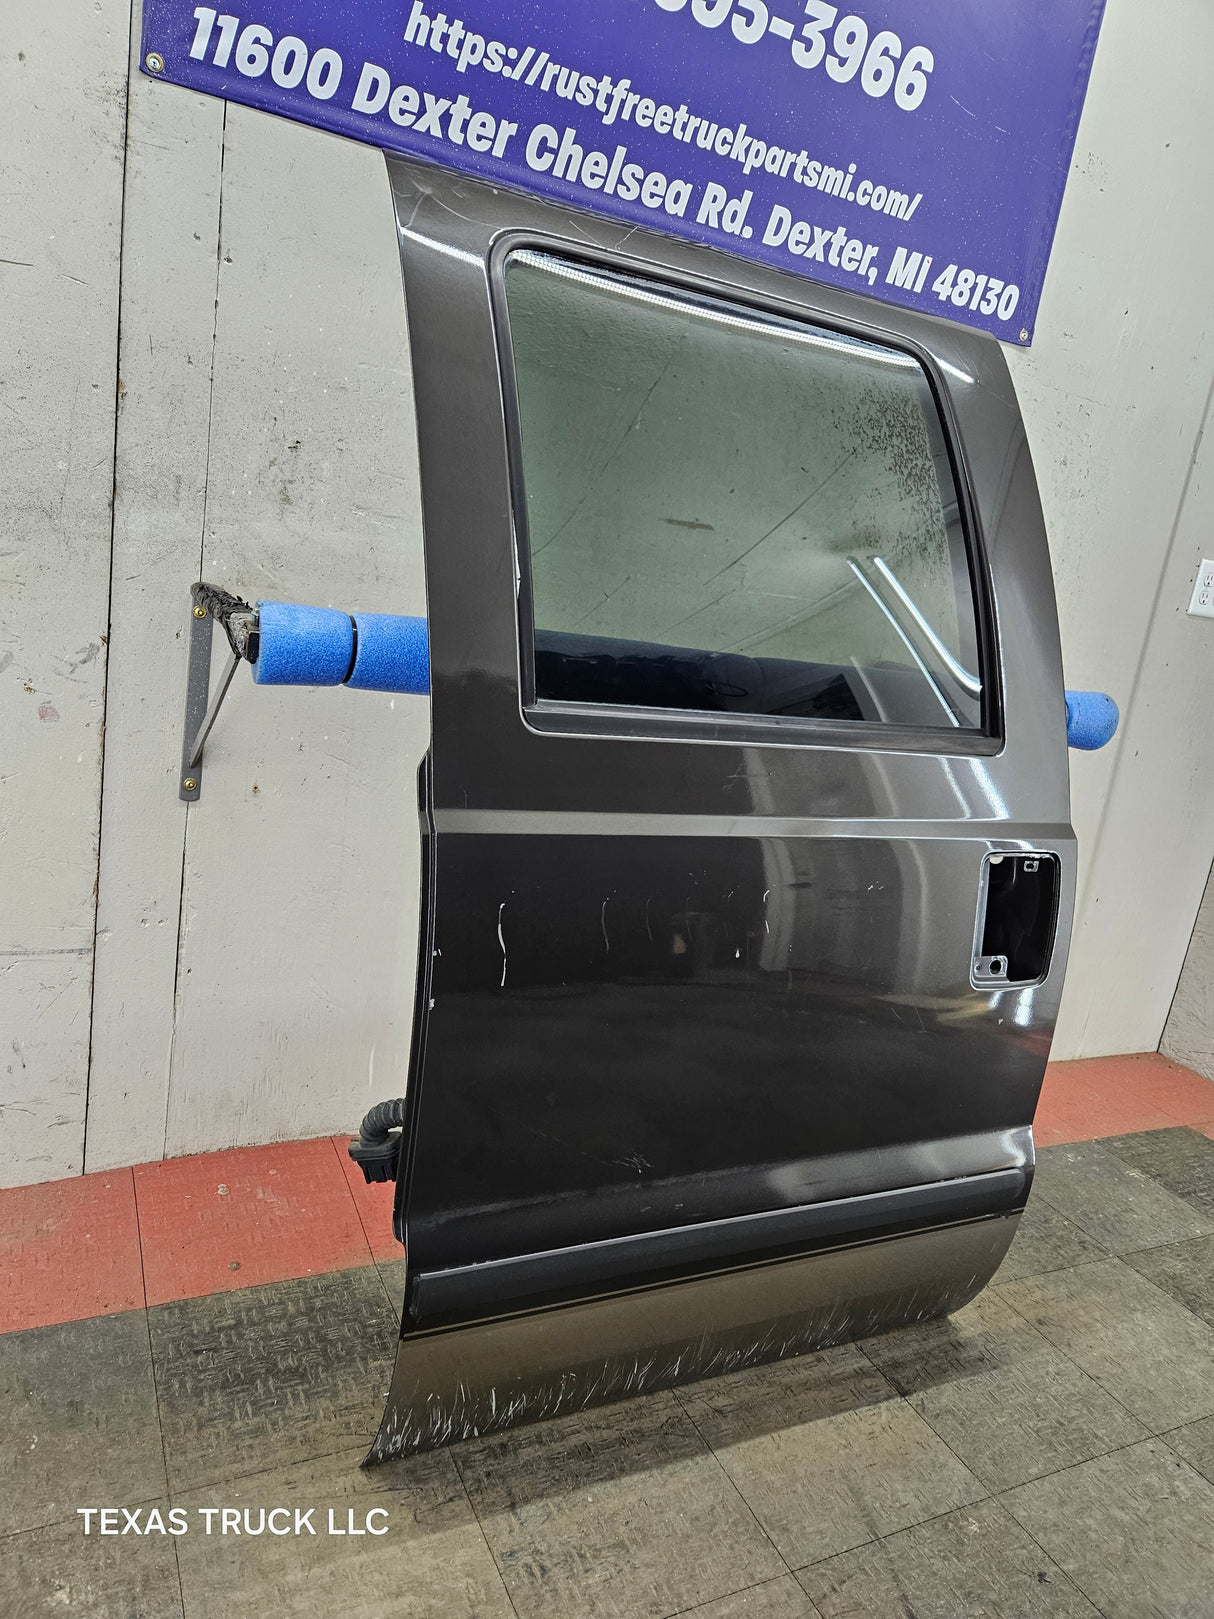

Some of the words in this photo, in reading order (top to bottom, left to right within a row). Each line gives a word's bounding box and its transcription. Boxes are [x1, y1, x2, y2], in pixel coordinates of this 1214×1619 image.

[188, 7, 342, 99] 11600
[351, 62, 517, 158] Dexter
[525, 123, 694, 217] Chelsea
[695, 182, 754, 239] Rd.
[761, 204, 880, 286] Dexter,
[885, 245, 934, 294] MI
[930, 263, 1020, 322] 48130
[403, 0, 923, 221] https://rustfreetruckpartsmi.com/
[655, 0, 934, 111] 5-3966
